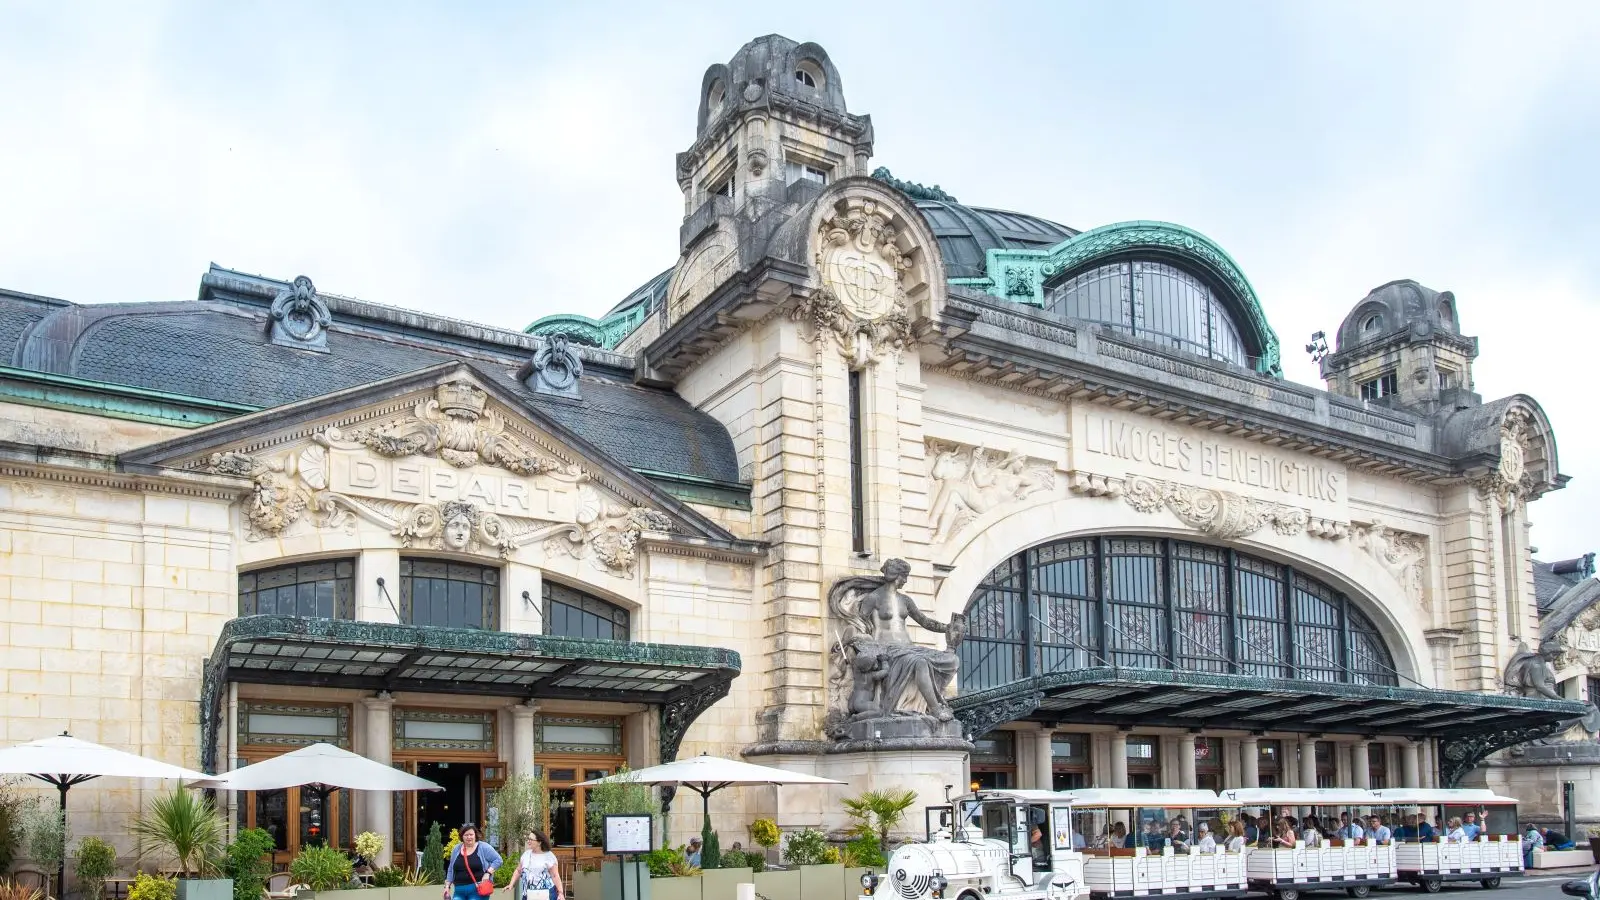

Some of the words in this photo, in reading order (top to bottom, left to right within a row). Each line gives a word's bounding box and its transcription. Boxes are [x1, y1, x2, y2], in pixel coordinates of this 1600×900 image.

[349, 457, 568, 514] DEPART
[1085, 414, 1193, 472] LIMOGES
[1200, 441, 1338, 503] BENEDICTINS
[1195, 748, 1209, 756] SNCF
